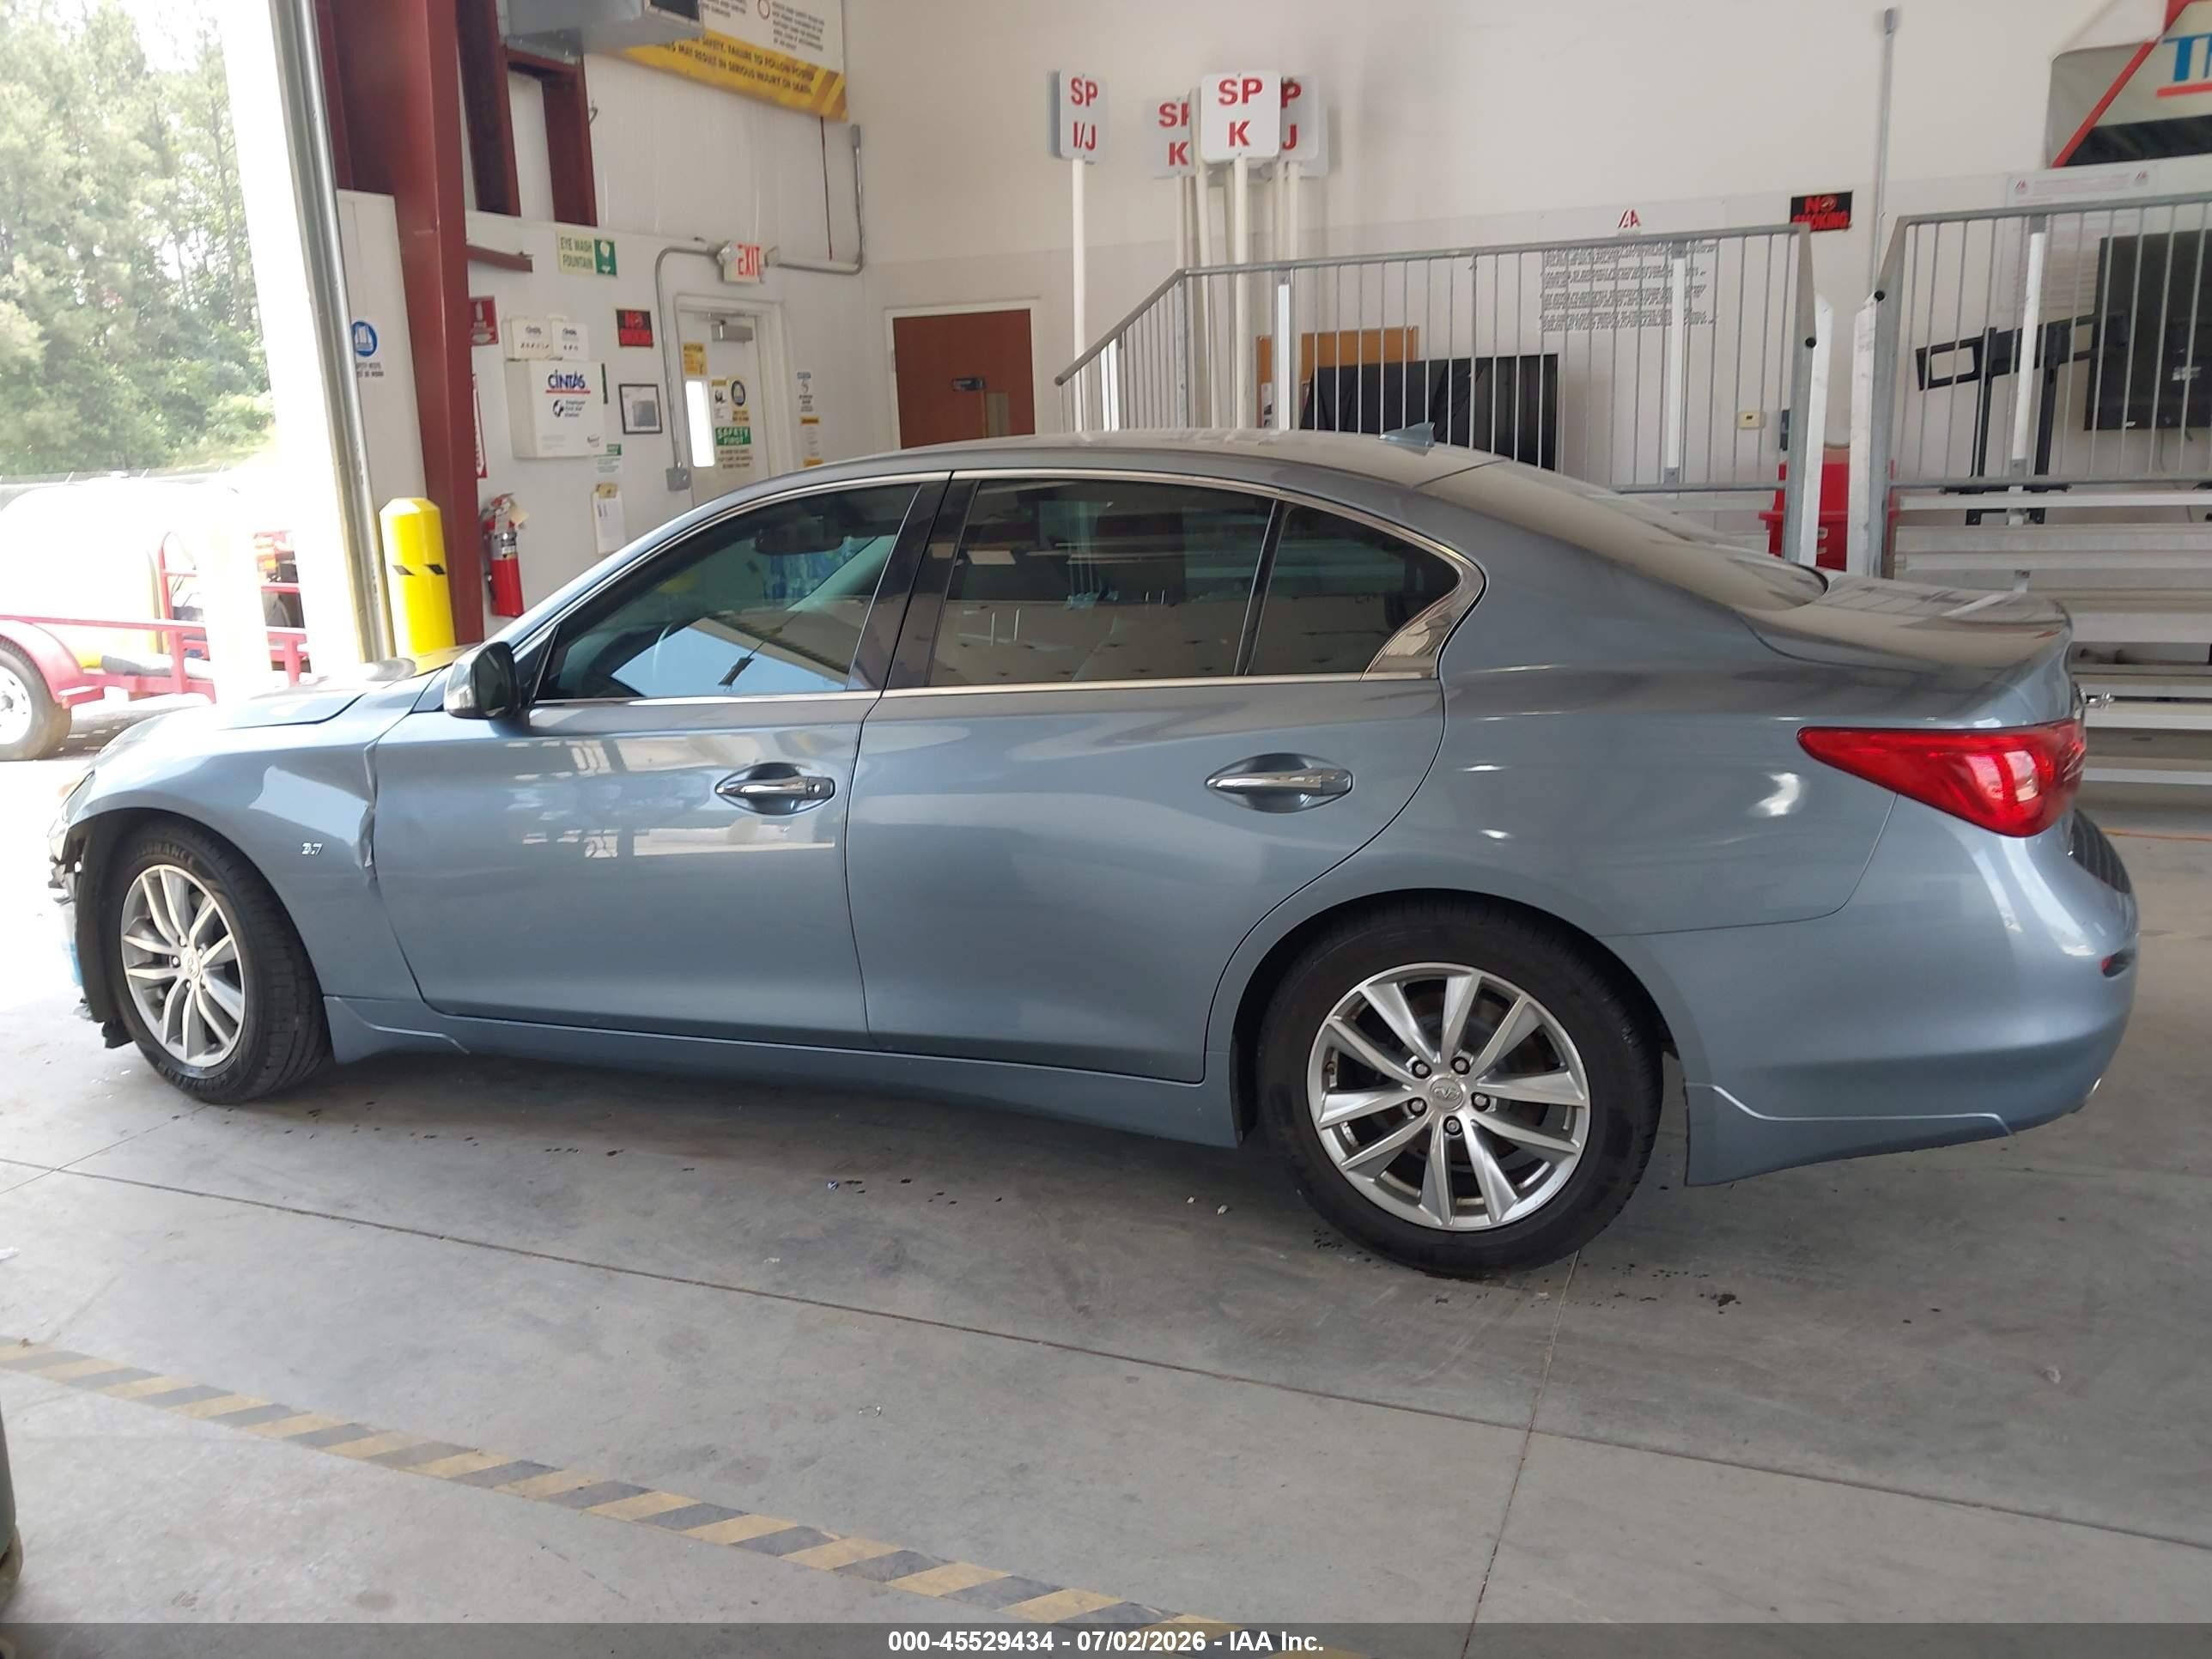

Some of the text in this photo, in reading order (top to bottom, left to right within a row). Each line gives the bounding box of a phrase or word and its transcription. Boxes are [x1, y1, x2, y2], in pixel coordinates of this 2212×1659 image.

[1071, 77, 1098, 107] SP
[1218, 78, 1263, 106] SP
[1280, 82, 1302, 108] P
[1073, 121, 1096, 151] I/J
[1229, 121, 1250, 147] K
[1169, 142, 1188, 166] K
[560, 236, 573, 252] EYE
[737, 244, 761, 276] EXIT
